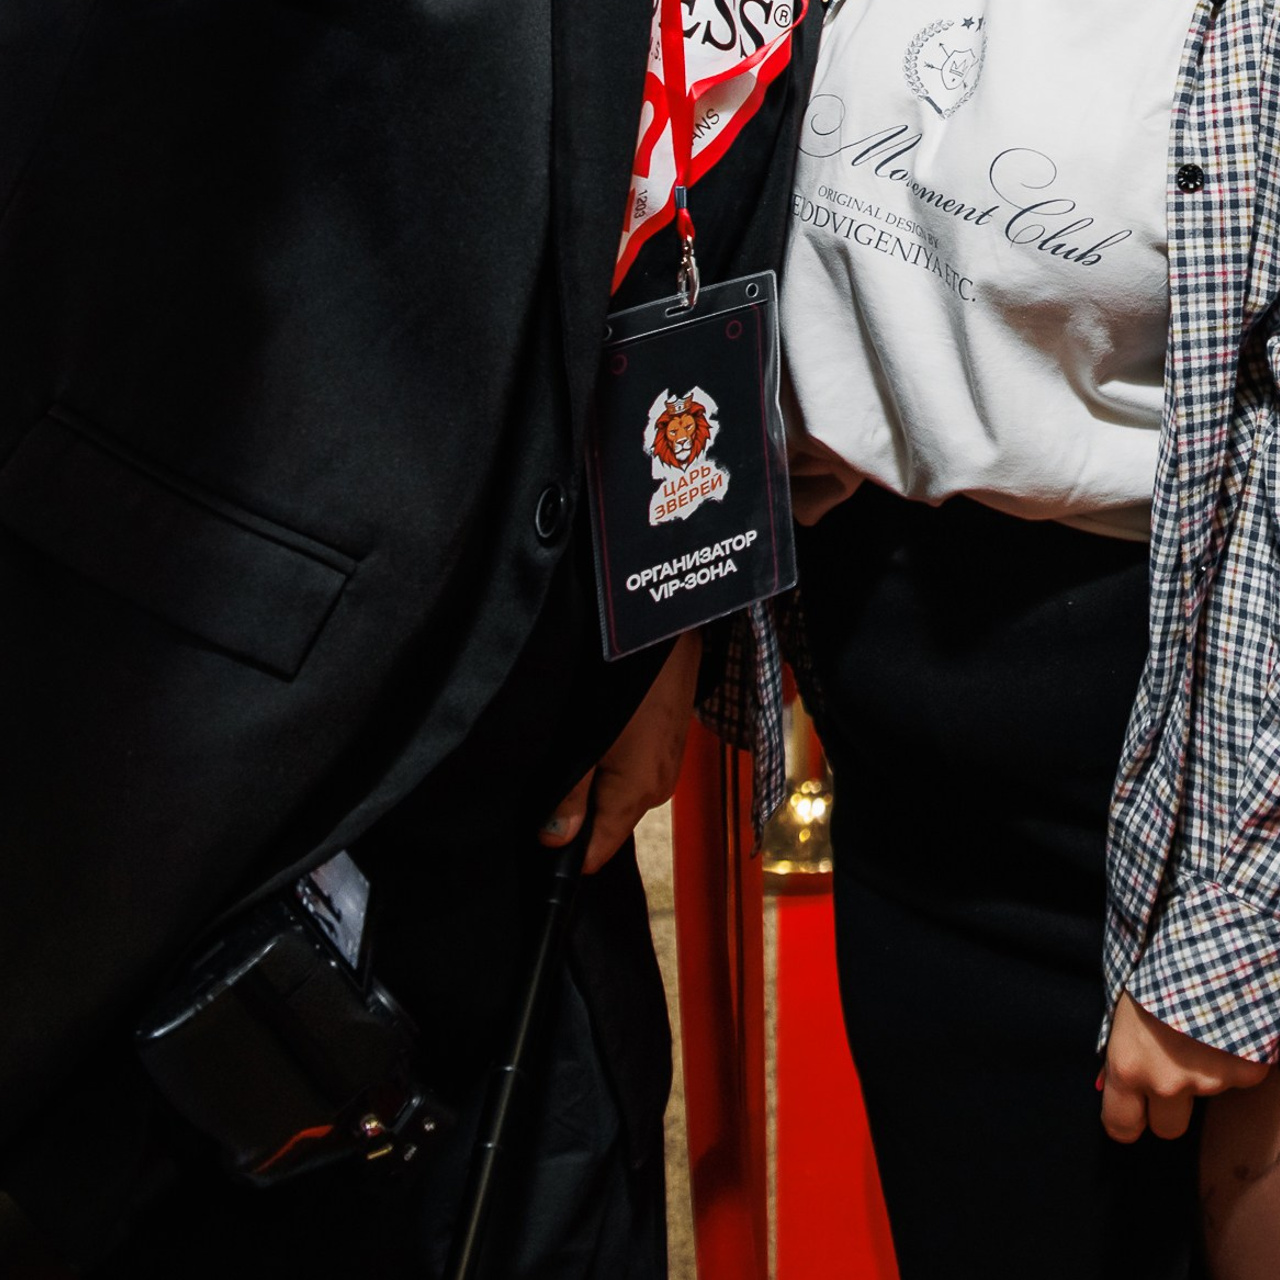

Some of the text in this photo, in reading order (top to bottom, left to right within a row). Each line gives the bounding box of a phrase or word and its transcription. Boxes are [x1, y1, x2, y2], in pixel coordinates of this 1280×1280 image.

[798, 94, 1133, 267] Movement Club
[817, 185, 940, 249] ORIGINAL DESIGN BY
[944, 263, 976, 302] ETC.
[654, 474, 723, 520] ЗВЕРЕЙ
[662, 465, 711, 499] ЦАРЬ
[626, 531, 757, 591] ОРГАНИЗАТОР
[650, 559, 737, 602] VIP-ЗОНА
